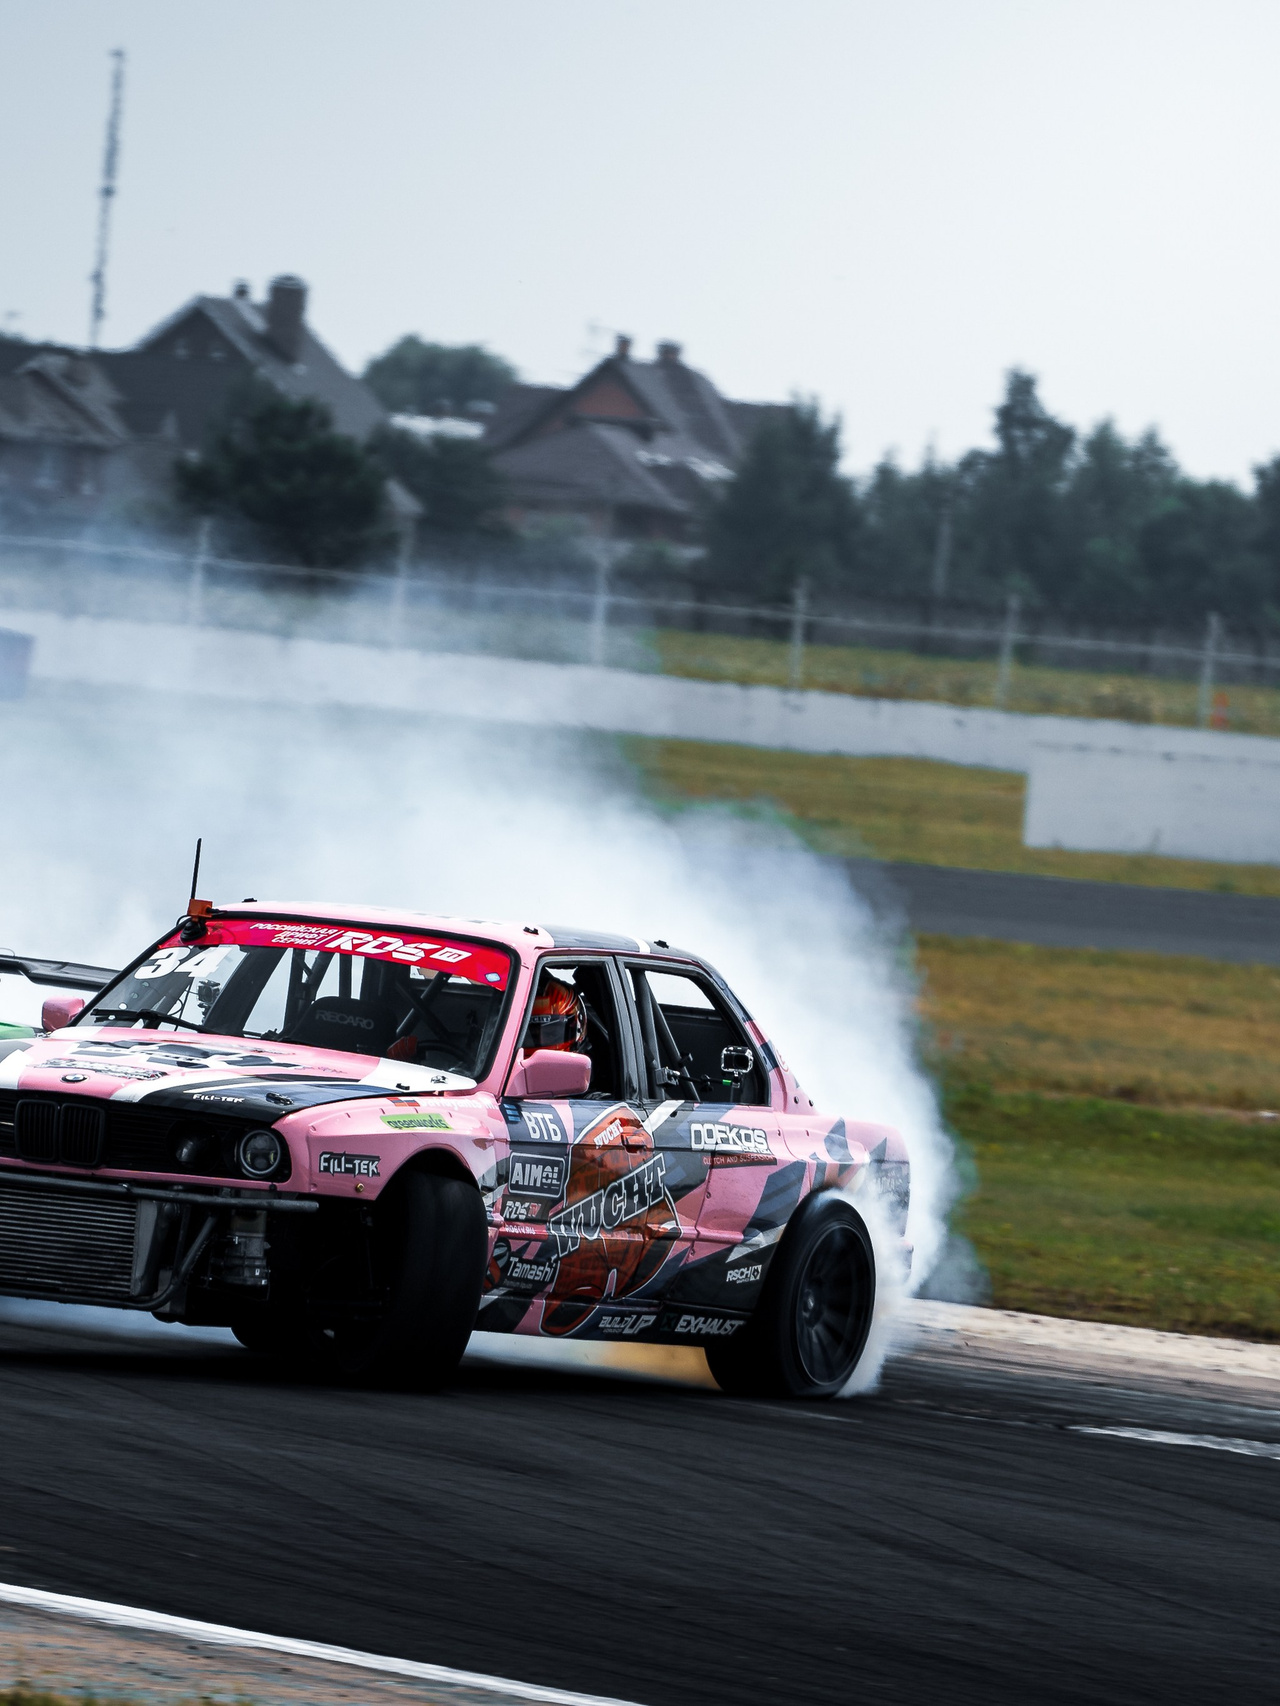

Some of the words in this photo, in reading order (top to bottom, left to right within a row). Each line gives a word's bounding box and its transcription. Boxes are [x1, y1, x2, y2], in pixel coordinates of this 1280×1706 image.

[325, 931, 441, 961] RDS
[133, 946, 232, 978] 34
[314, 1009, 374, 1030] RECARO
[387, 1115, 449, 1129] greenworks
[522, 1111, 562, 1142] ВТБ
[593, 1118, 624, 1149] WUCHT
[511, 1162, 560, 1189] AIMOL
[503, 1200, 531, 1220] RDS
[550, 1153, 666, 1258] WUCHT
[507, 1256, 556, 1282] Tamashi
[726, 1266, 752, 1282] RSCH
[598, 1315, 629, 1328] BUILD
[622, 1314, 657, 1334] UP
[674, 1314, 747, 1335] EXHAUST
